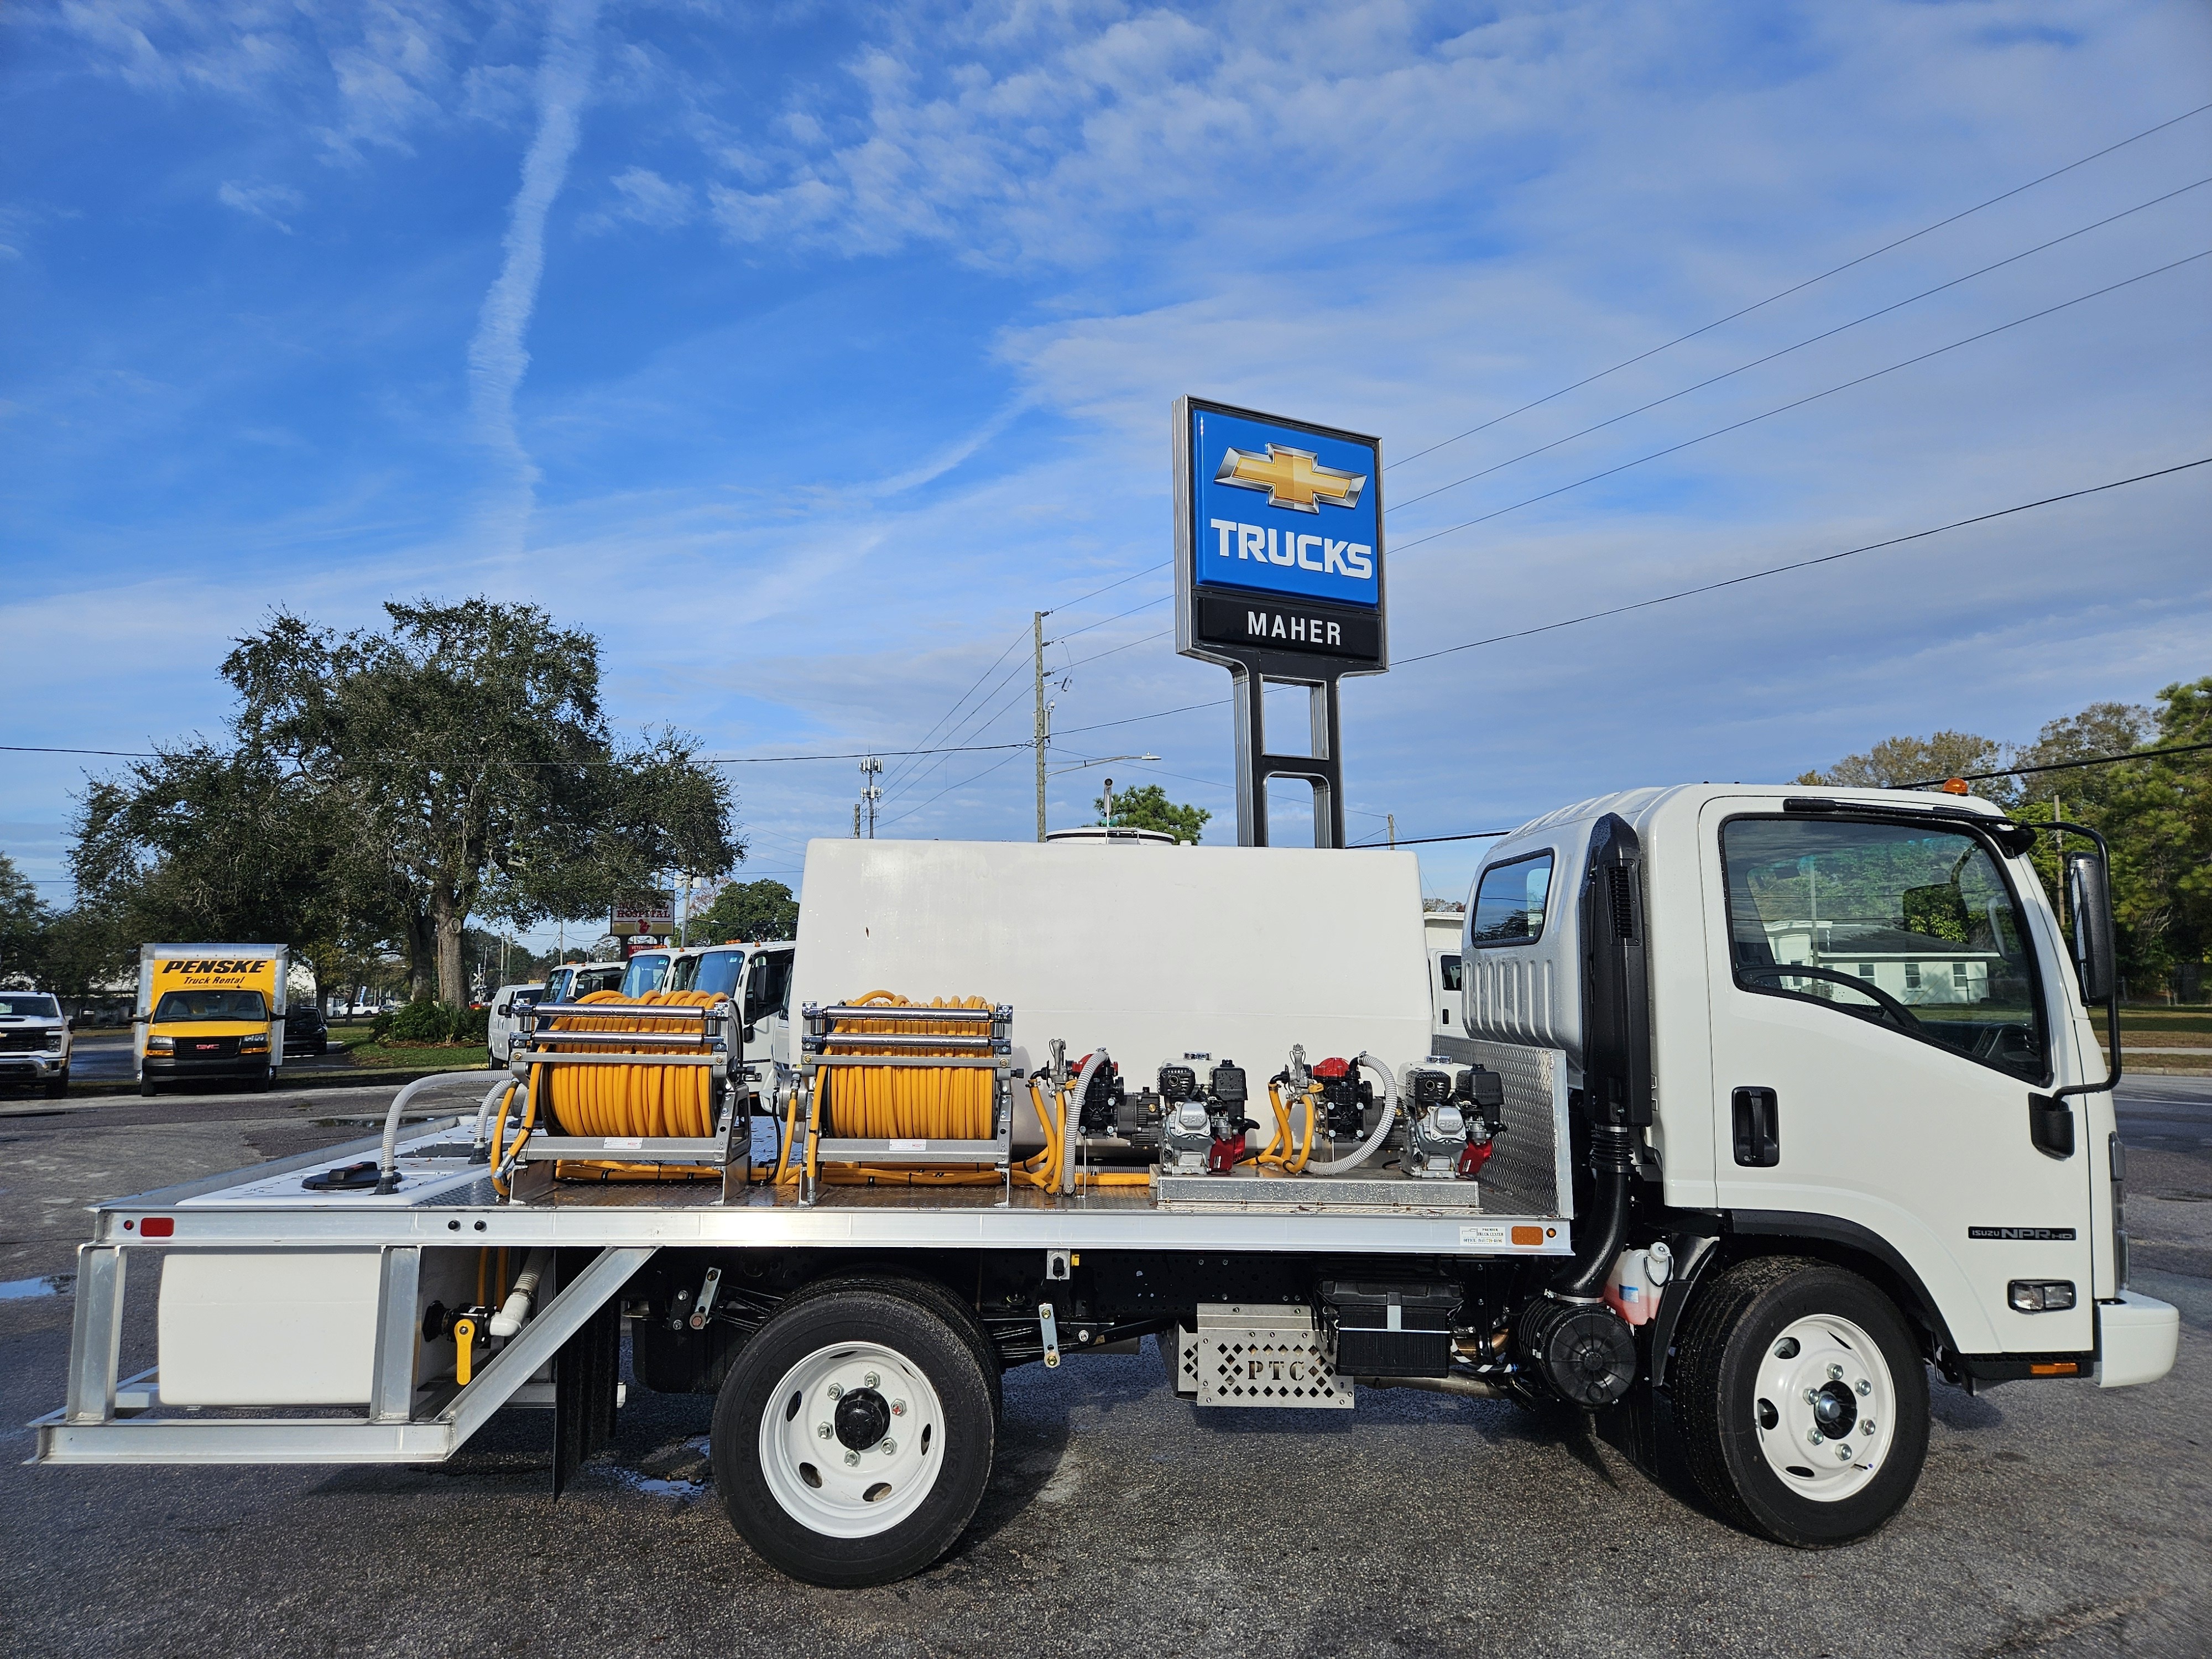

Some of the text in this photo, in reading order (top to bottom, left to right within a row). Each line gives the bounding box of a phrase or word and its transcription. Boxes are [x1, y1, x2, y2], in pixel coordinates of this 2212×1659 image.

[1211, 518, 1372, 579] TRUCKS
[1248, 611, 1340, 645] MAHER
[162, 960, 268, 974] PENSKE
[184, 976, 211, 984] Truck
[2001, 1228, 2051, 1239] NPR
[1248, 1360, 1305, 1381] PTC
